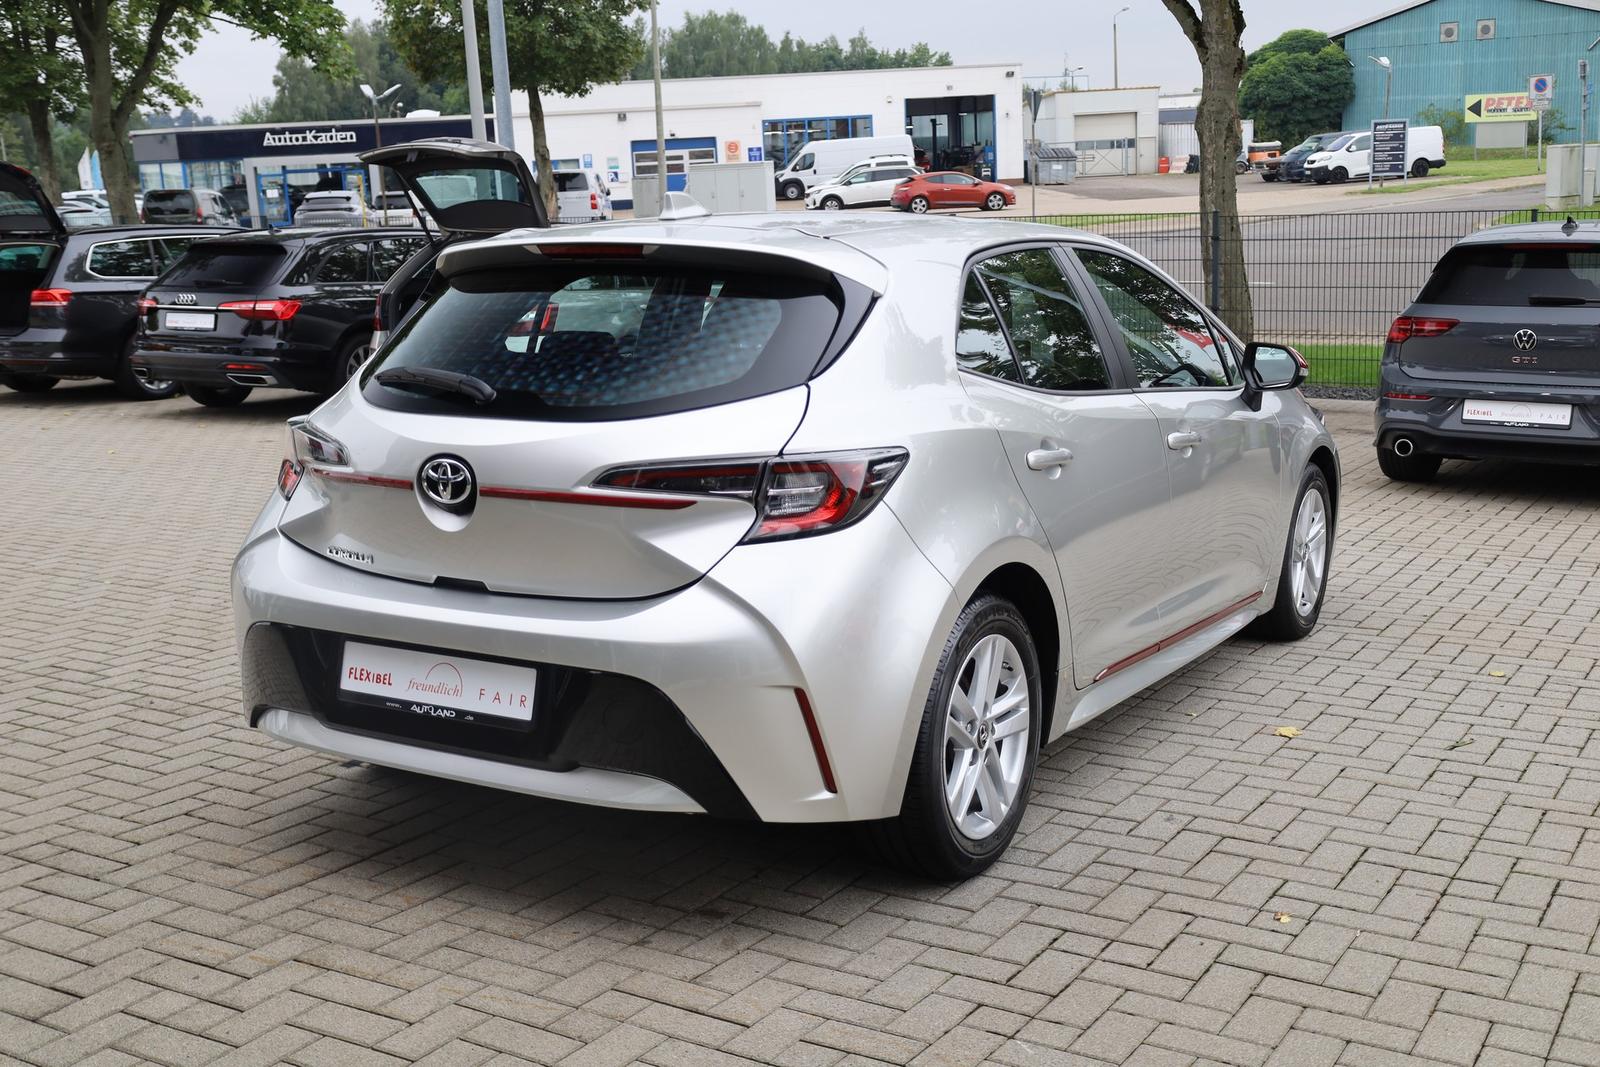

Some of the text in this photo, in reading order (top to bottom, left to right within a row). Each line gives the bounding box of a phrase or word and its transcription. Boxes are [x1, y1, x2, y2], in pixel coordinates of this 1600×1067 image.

[263, 128, 357, 146] Auto Kaden
[1512, 356, 1537, 364] GTI
[327, 546, 374, 565] COROLLA
[348, 667, 393, 686] FLEXIBEL
[406, 679, 461, 697] freundlich
[410, 704, 456, 718] AUTOLAND
